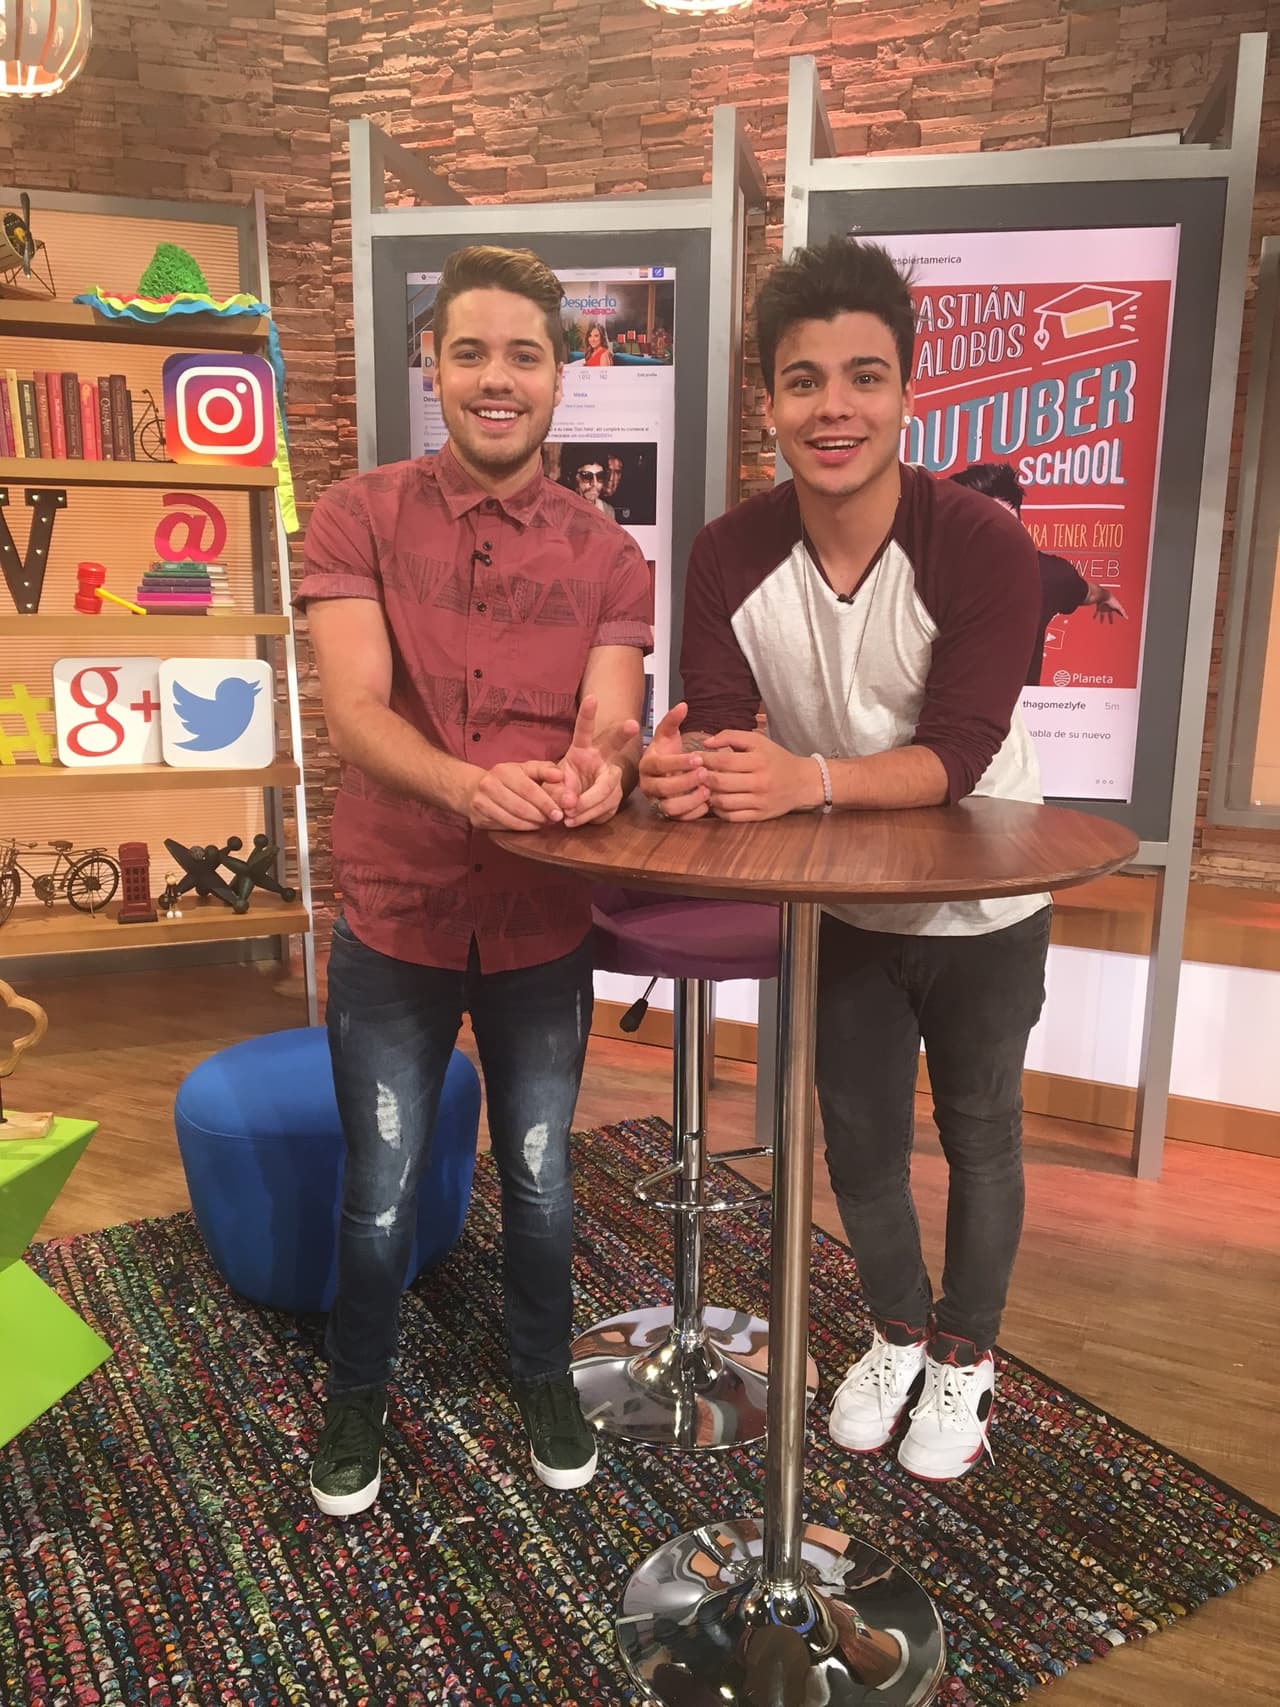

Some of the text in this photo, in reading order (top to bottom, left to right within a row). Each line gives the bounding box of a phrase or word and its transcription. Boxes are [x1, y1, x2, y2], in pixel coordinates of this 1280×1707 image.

[910, 285, 1026, 335] ASTIÁN
[914, 324, 1026, 381] ALOBOS
[1018, 438, 1127, 487] SCHOOL
[1053, 523, 1088, 548] TENER
[1092, 519, 1124, 549] ÉXITO
[1070, 559, 1120, 578] WEB
[1072, 673, 1114, 685] Planeta
[1104, 702, 1120, 711] 5m
[1054, 730, 1066, 739] de
[1069, 731, 1080, 739] su
[1082, 732, 1112, 741] nuevo
